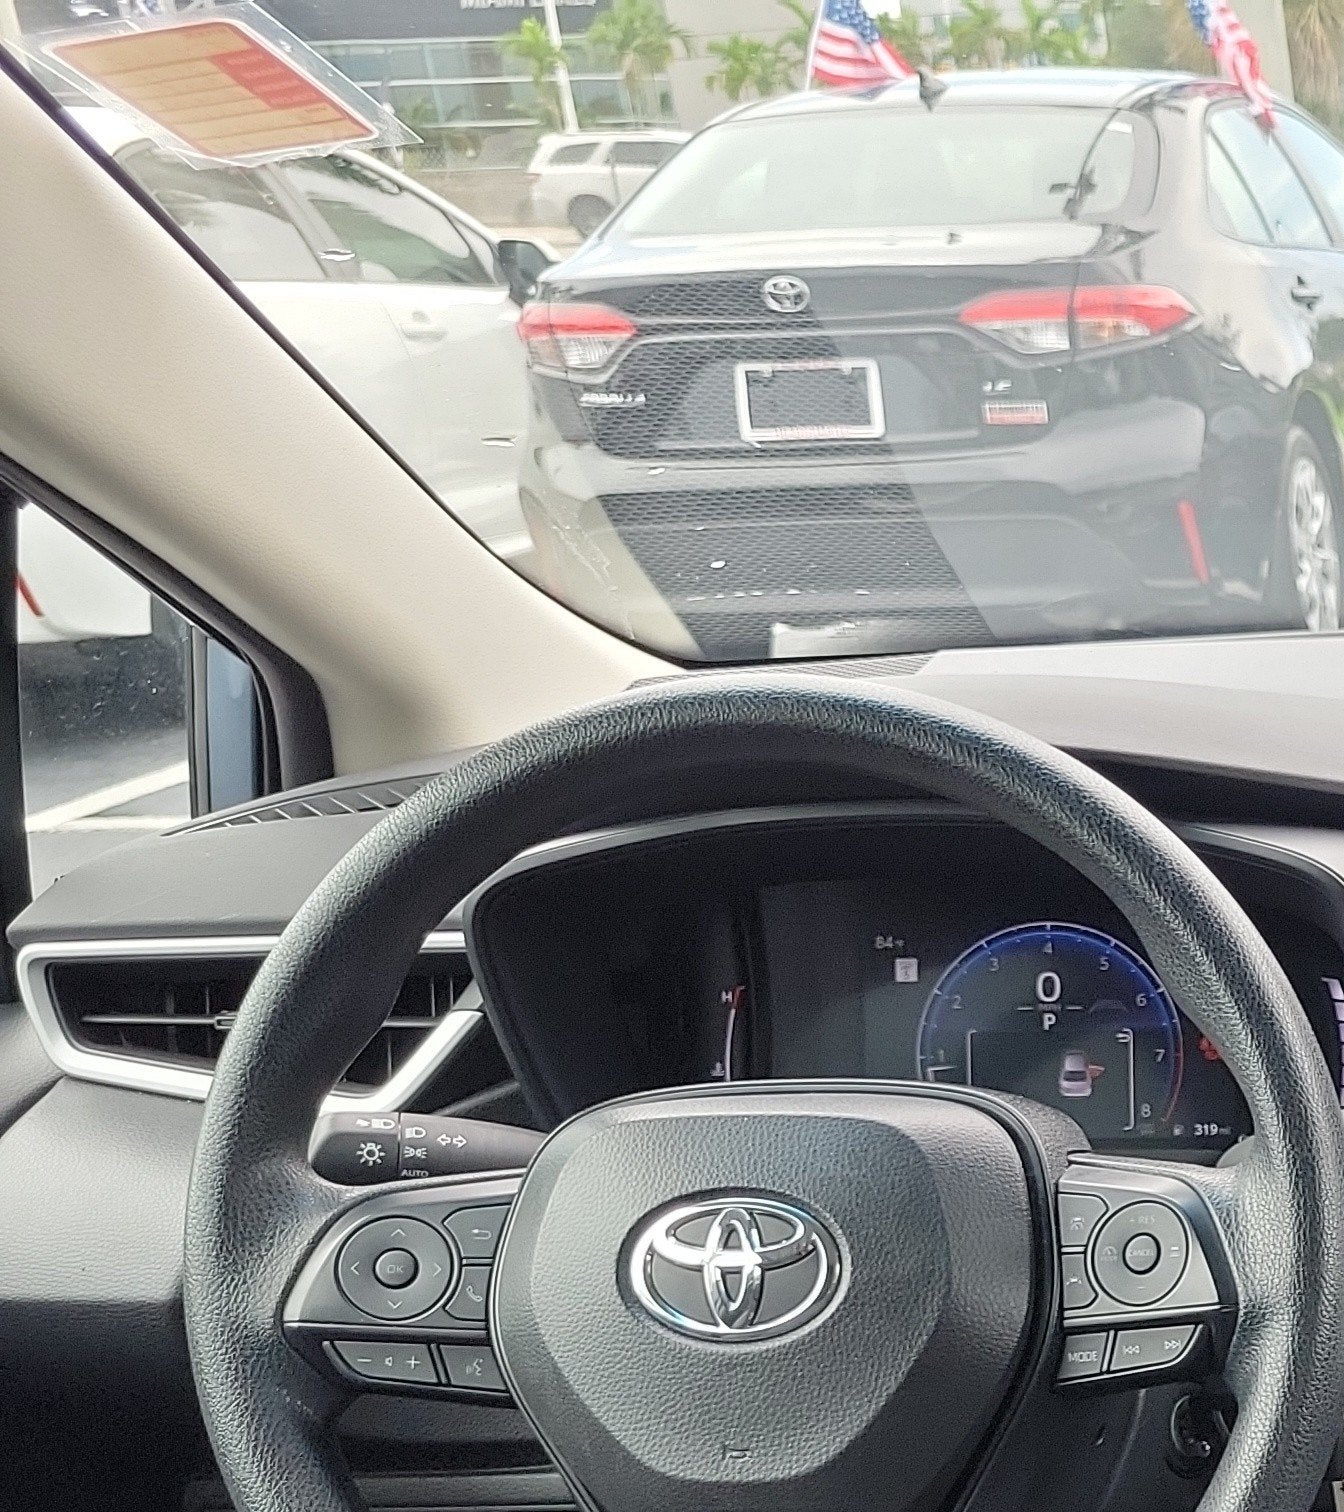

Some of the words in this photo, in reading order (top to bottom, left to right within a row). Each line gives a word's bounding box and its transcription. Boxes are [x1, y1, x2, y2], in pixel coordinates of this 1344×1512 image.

[1044, 942, 1053, 954] 4
[990, 957, 999, 971] 3
[1099, 957, 1109, 971] 5
[1035, 971, 1062, 1003] 0
[721, 990, 733, 1003] H
[953, 995, 962, 1010] 2
[1135, 993, 1147, 1008] 6
[1042, 1013, 1056, 1031] P
[1155, 1049, 1165, 1063] 7
[1141, 1103, 1151, 1119] 8
[1193, 1123, 1218, 1136] 319
[401, 1169, 428, 1178] AUTO
[387, 1265, 403, 1274] OK
[1067, 1351, 1098, 1363] MODE
